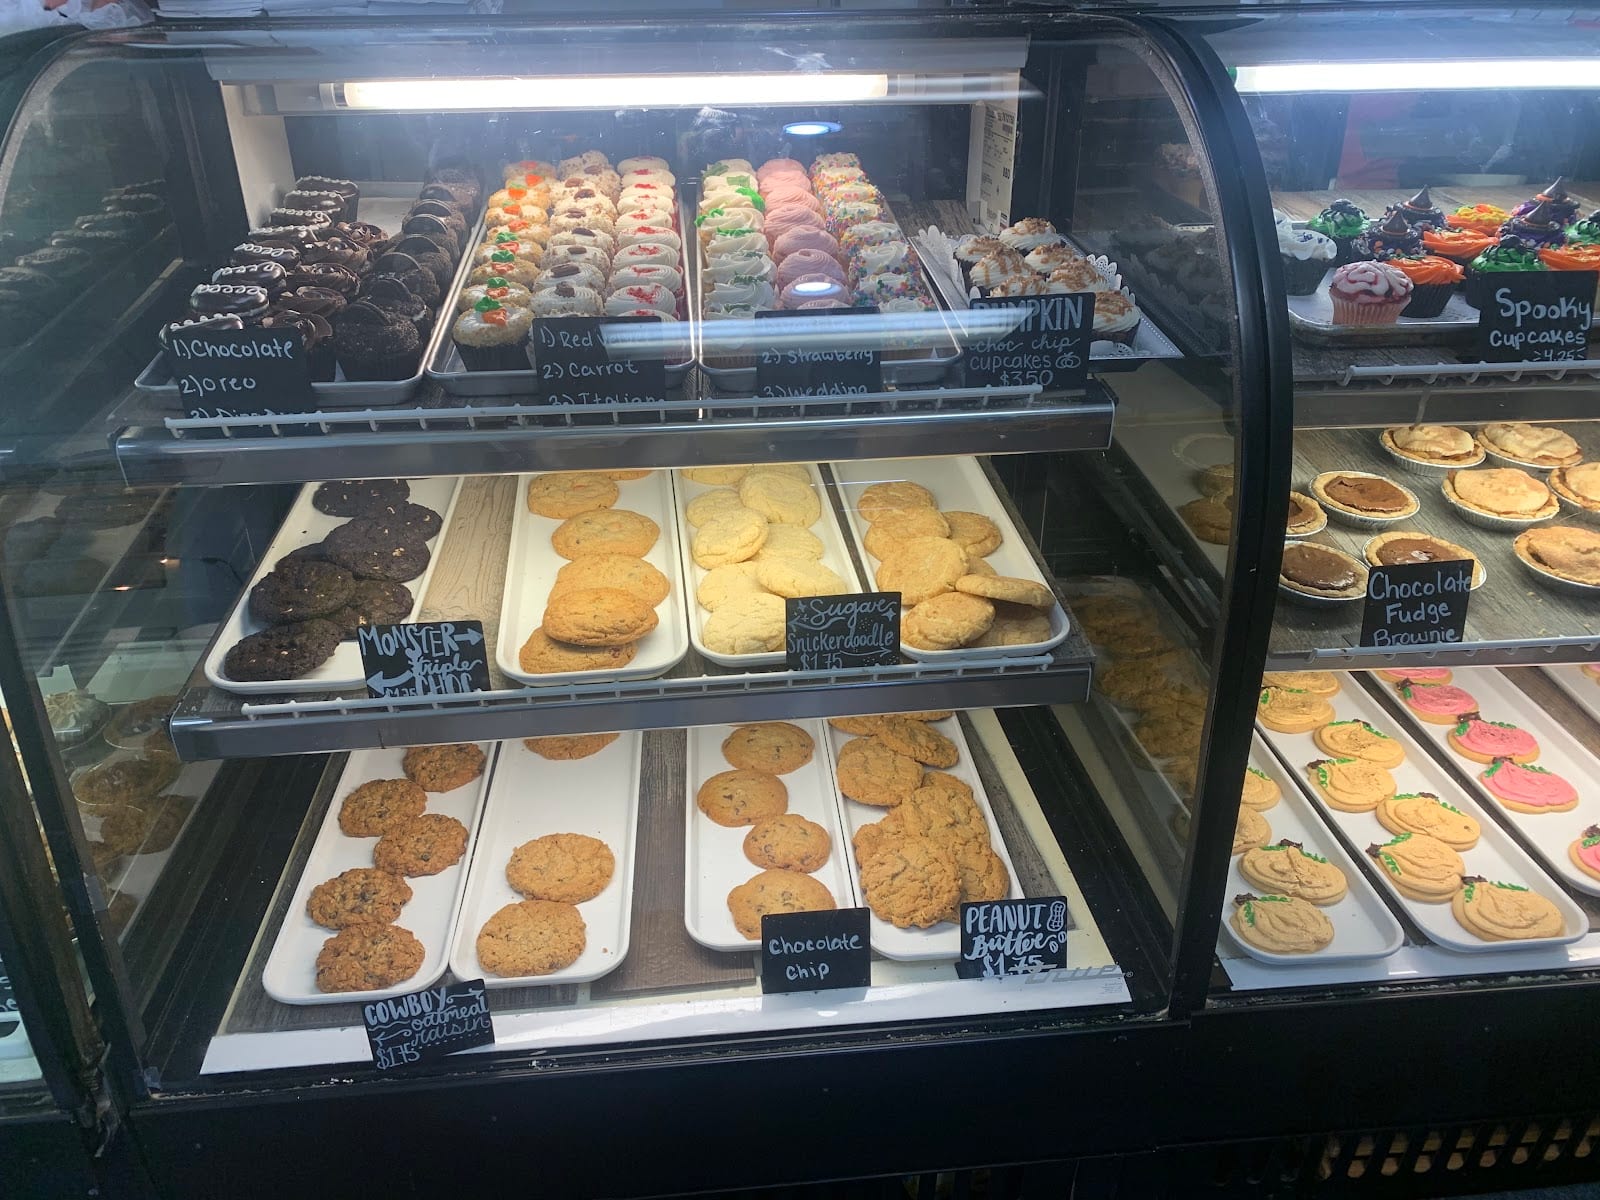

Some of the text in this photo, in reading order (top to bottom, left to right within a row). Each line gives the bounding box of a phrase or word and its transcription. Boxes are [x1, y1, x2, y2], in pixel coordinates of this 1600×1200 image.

[973, 296, 1083, 332] MPKIN
[1496, 288, 1591, 330] Spooky
[559, 331, 593, 348] Red
[1032, 333, 1080, 353] chip
[569, 360, 638, 377] Carrot
[788, 348, 873, 365] Strawberry
[970, 354, 1050, 373] cupcakes
[1369, 570, 1472, 600] Chocolate
[810, 598, 897, 629] Sugar
[1386, 602, 1451, 624] Fudge
[358, 622, 459, 657] MONSTER
[788, 622, 894, 653] Snickerdoodle
[1373, 627, 1459, 647] Brownie
[966, 904, 1047, 934] PEANUT
[964, 931, 1057, 960] Butter
[365, 988, 447, 1025] COWBOY
[411, 996, 489, 1030] oatmeal
[411, 1016, 491, 1046] raisin
